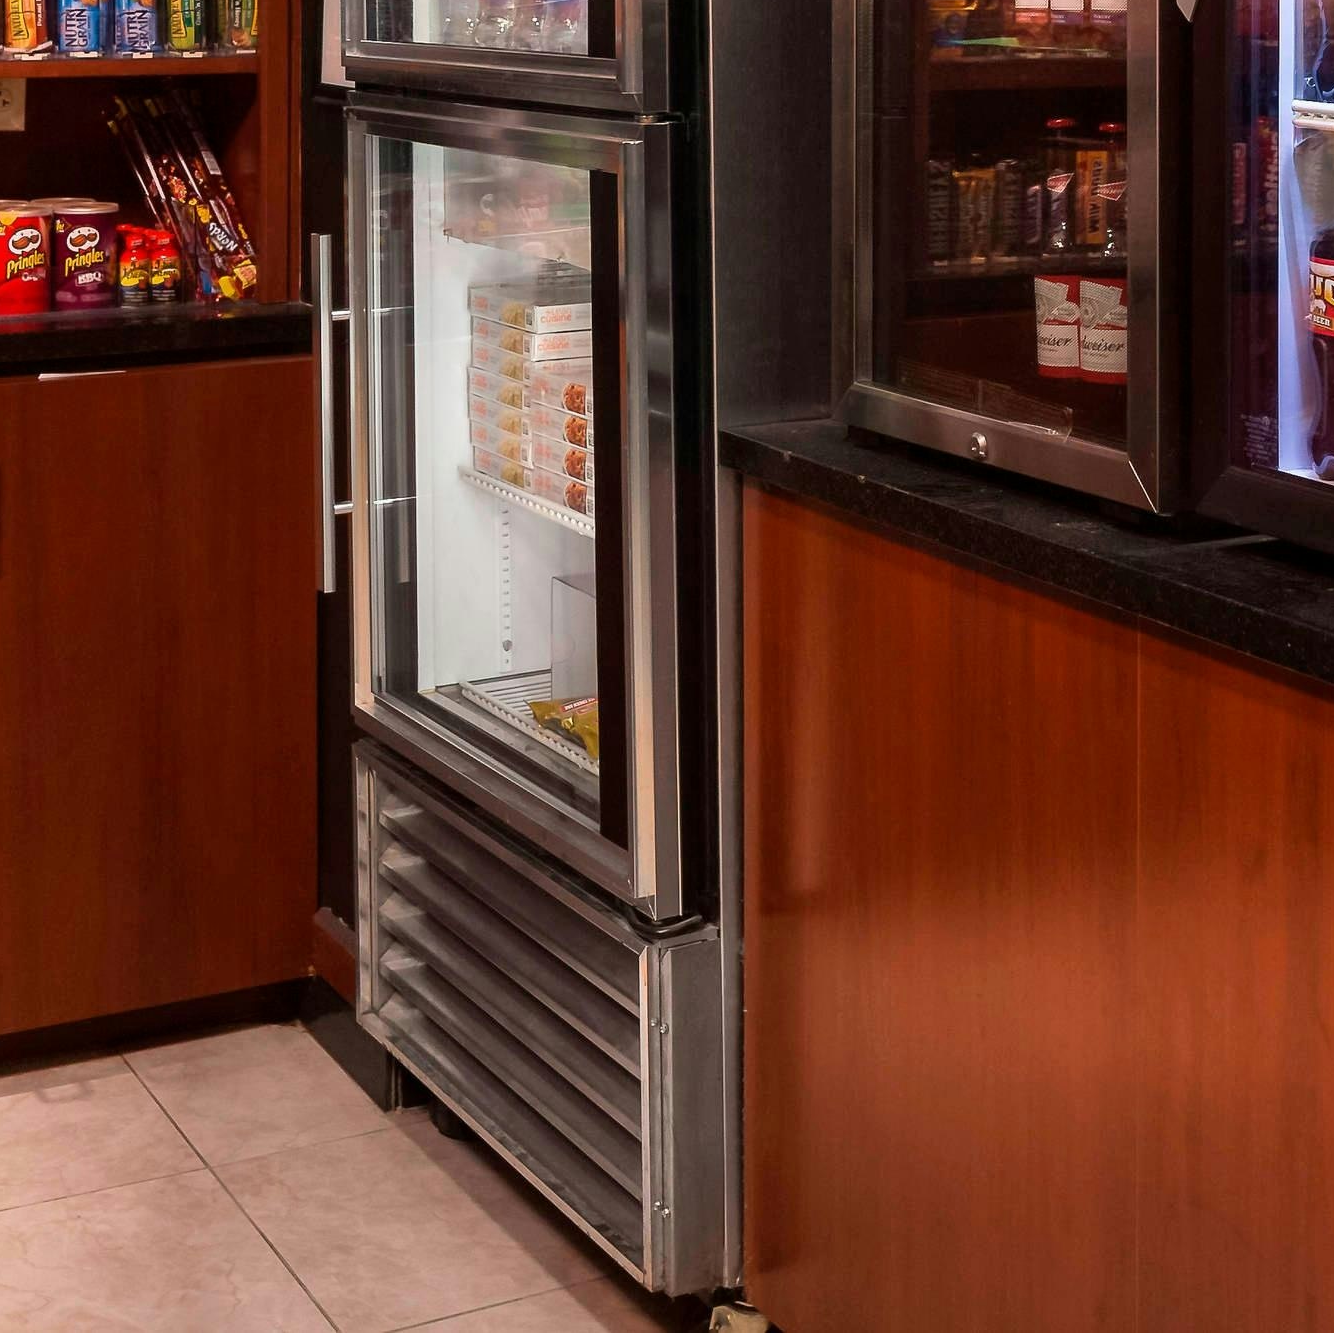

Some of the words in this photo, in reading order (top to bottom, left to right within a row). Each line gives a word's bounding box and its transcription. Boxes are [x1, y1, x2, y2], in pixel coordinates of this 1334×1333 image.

[65, 9, 77, 48] NUTRI
[76, 8, 88, 48] GRAIN
[6, 250, 45, 280] Pringles
[65, 248, 105, 277] Pringles
